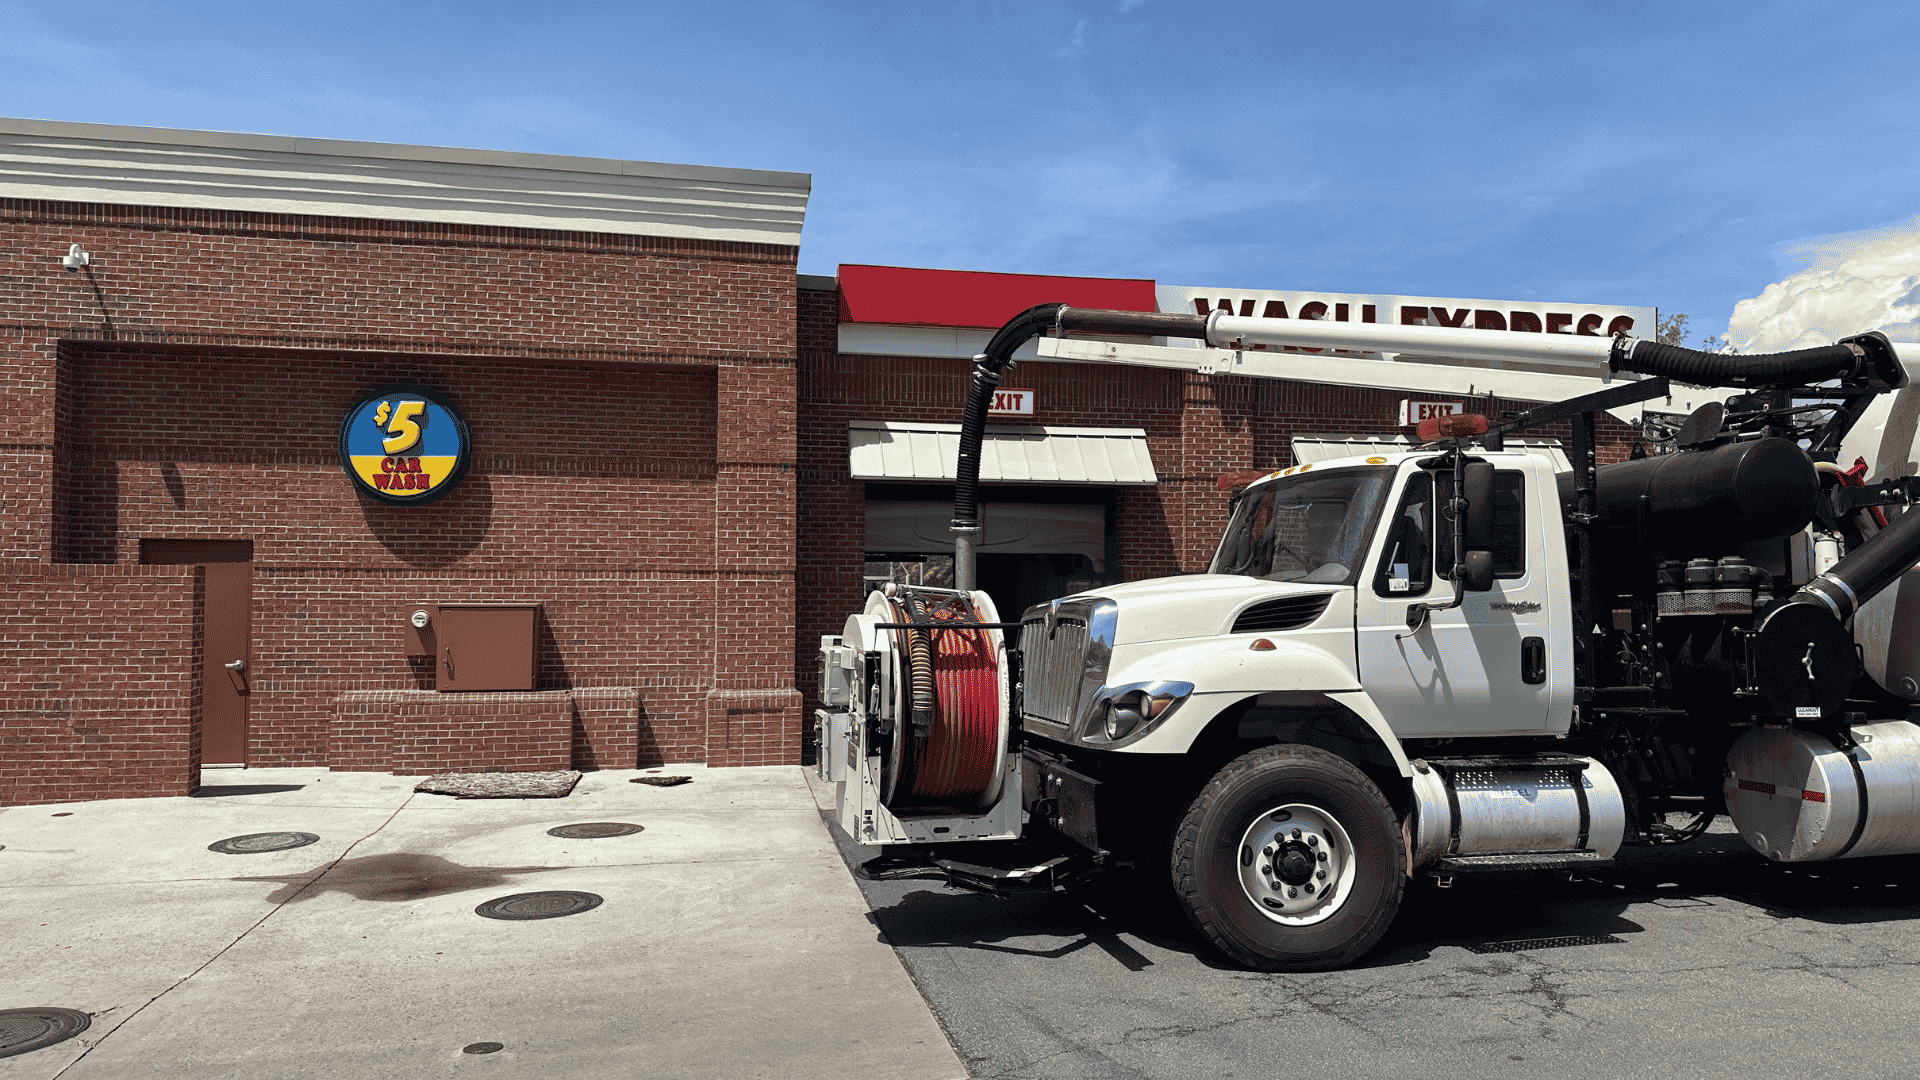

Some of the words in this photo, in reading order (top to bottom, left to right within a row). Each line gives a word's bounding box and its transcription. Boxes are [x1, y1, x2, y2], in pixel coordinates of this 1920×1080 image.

[989, 394, 1023, 410] XIT
[1419, 405, 1453, 419] EXIT
[372, 400, 426, 455] $5
[380, 457, 422, 473] CAR
[372, 473, 431, 490] WASH
